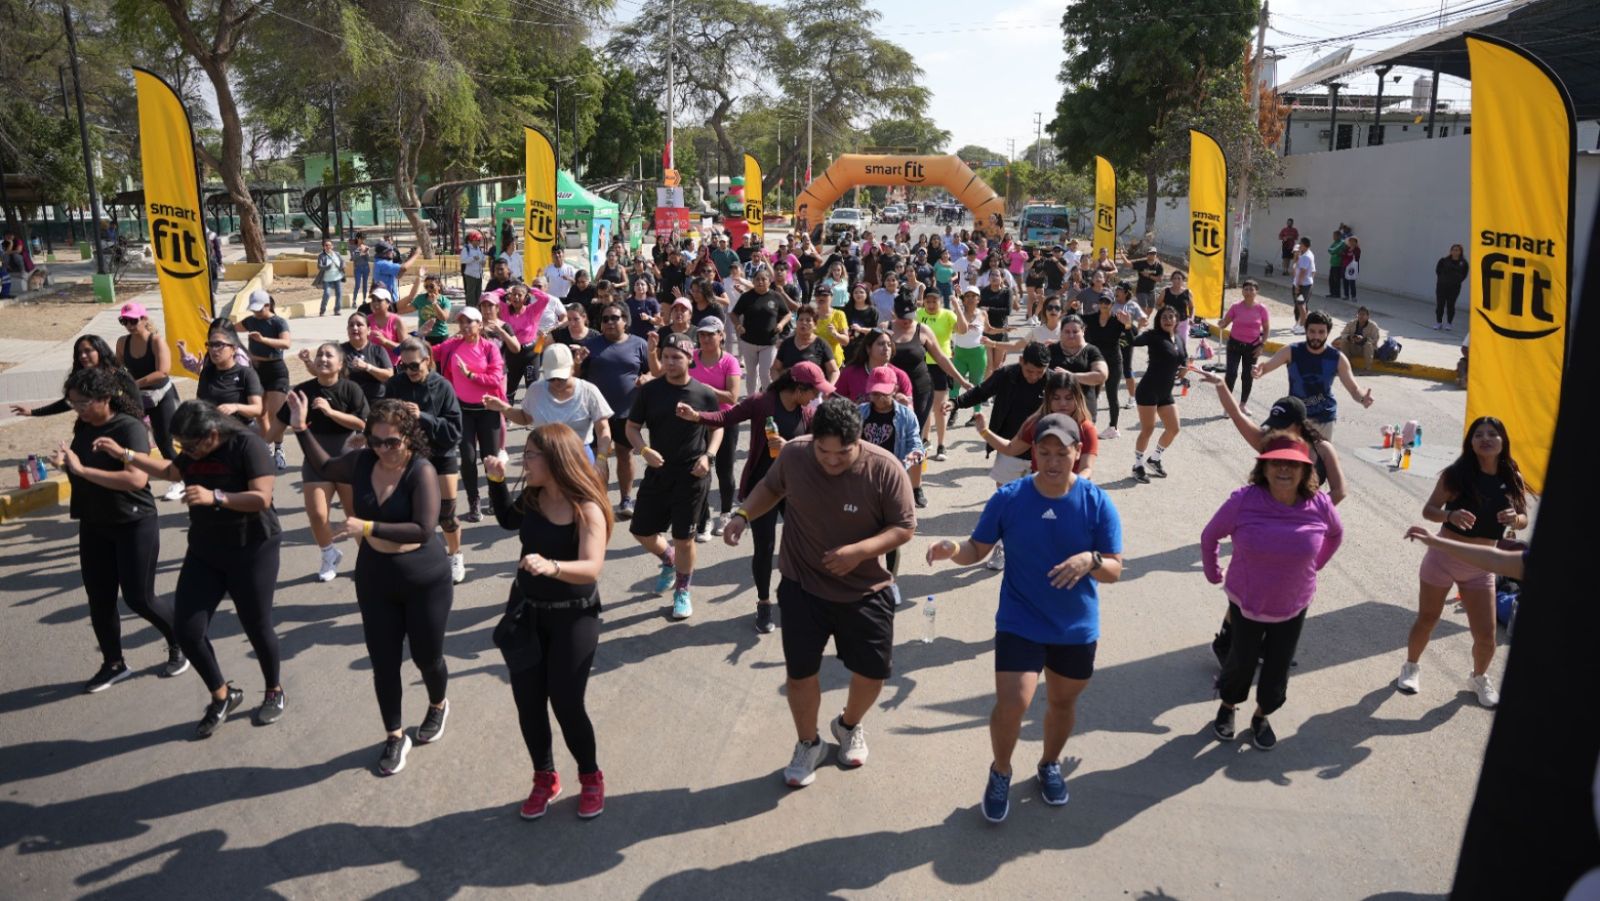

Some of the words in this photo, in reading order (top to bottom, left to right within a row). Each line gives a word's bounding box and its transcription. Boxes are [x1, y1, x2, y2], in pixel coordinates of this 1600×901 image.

[864, 163, 902, 176] smart
[904, 160, 926, 179] fit
[149, 202, 197, 222] smart
[530, 200, 553, 213] smart
[745, 203, 762, 221] fit
[1192, 210, 1221, 223] smart
[529, 208, 553, 237] fit
[1097, 208, 1113, 228] fit
[152, 218, 200, 268] fit
[1192, 219, 1220, 249] fit
[1480, 229, 1556, 258] smart
[1480, 251, 1555, 324] fit
